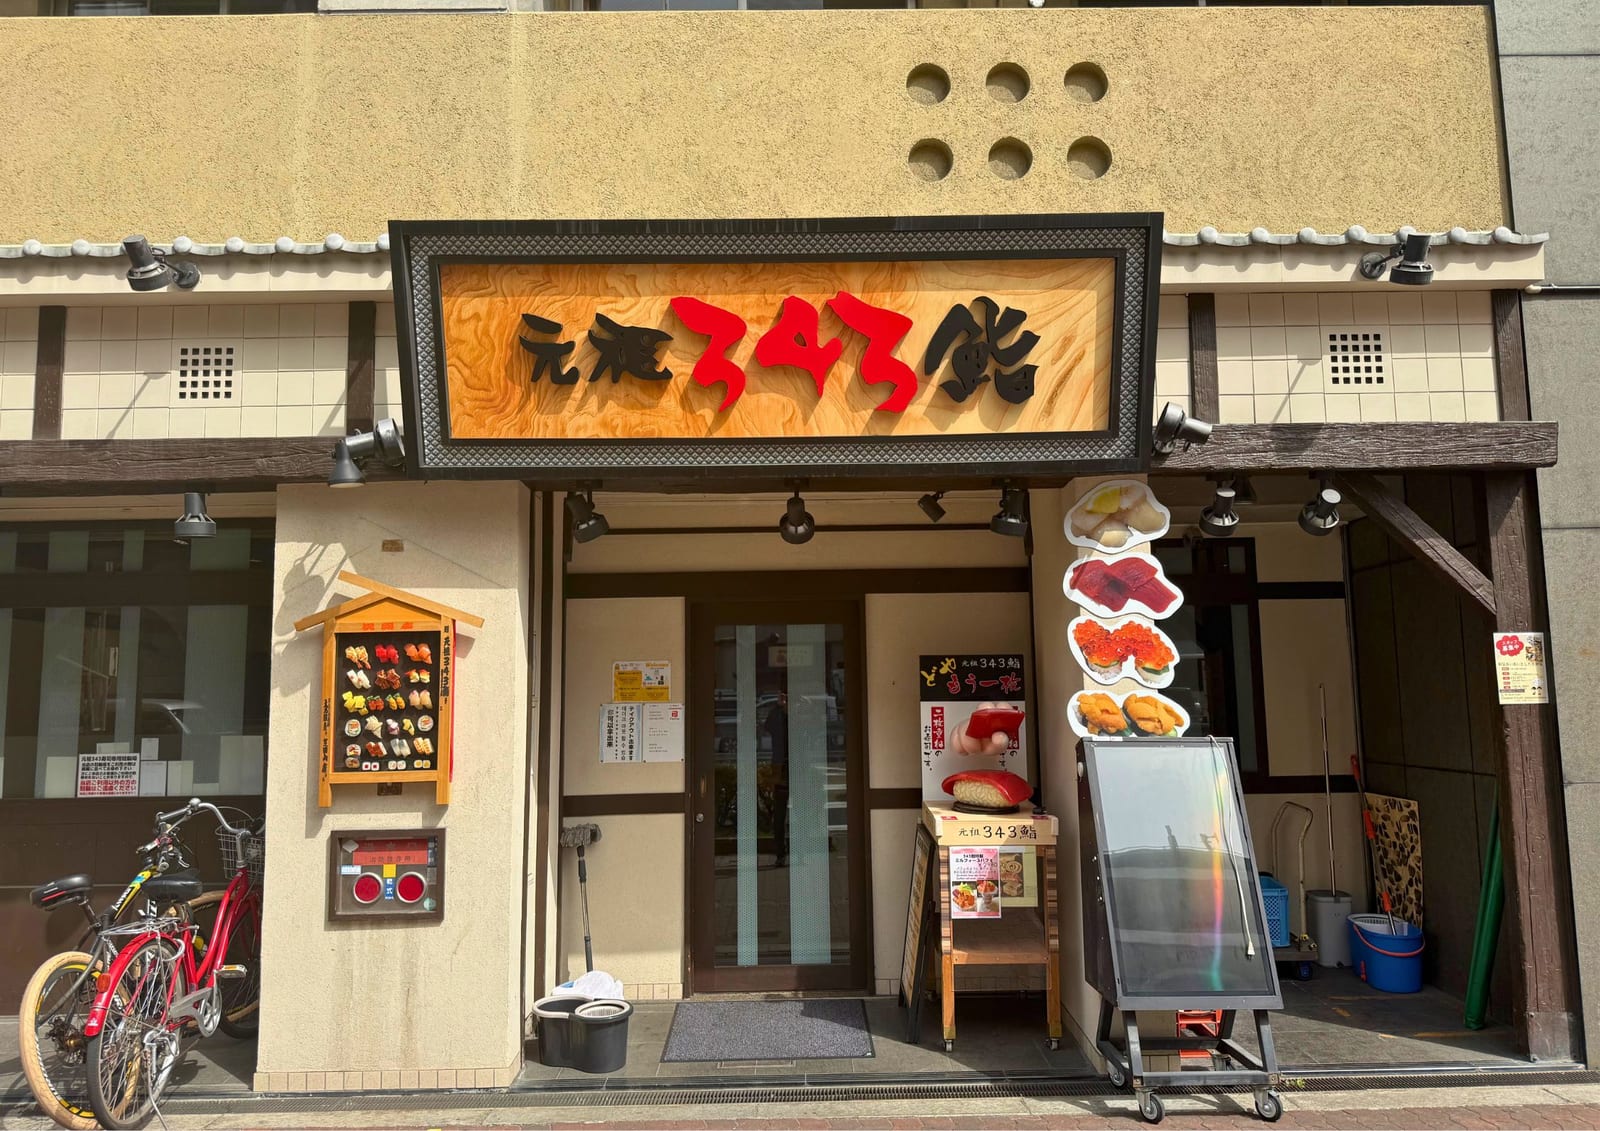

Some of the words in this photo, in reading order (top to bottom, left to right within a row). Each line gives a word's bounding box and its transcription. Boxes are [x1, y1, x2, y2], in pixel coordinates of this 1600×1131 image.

[947, 672, 1022, 694] もう一枚
[958, 824, 1037, 840] 元祖343鮨
